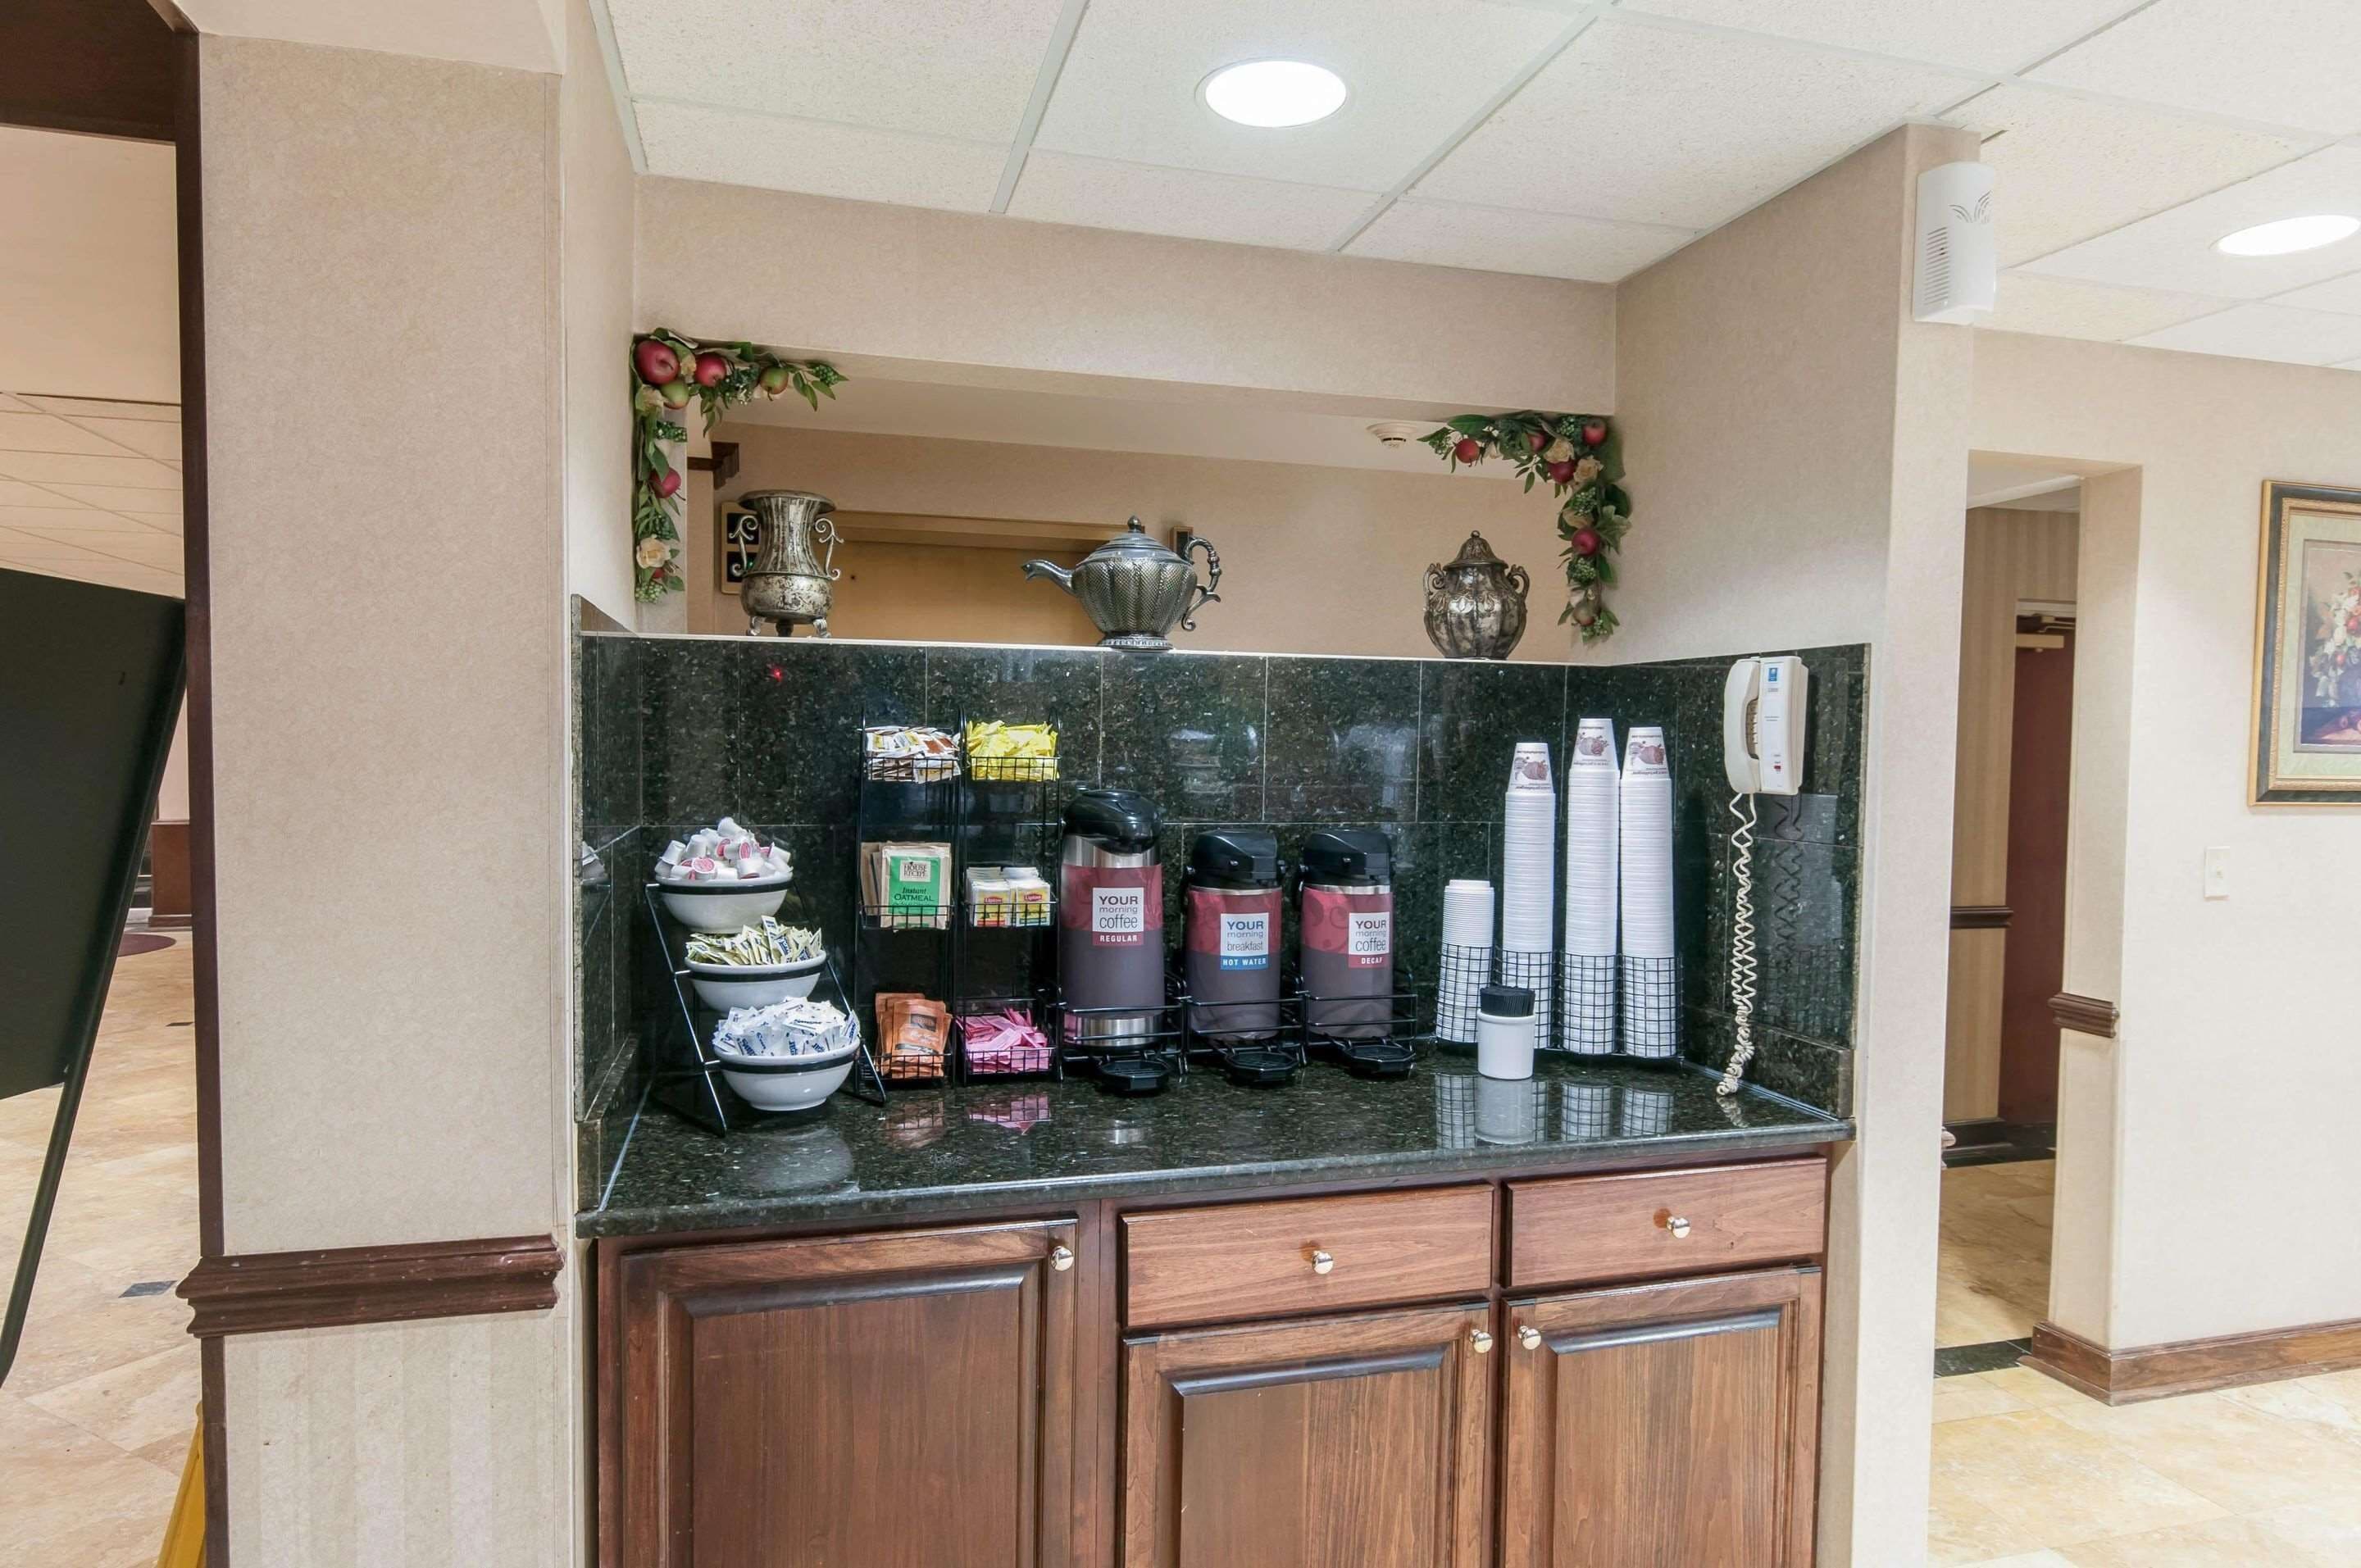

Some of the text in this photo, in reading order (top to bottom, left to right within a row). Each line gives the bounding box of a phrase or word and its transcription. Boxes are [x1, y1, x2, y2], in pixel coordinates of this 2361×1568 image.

[894, 893, 934, 902] OATMEAL
[1099, 896, 1139, 905] YOUR
[1099, 906, 1138, 914] morning
[1099, 914, 1138, 929] coffee
[1226, 920, 1264, 930] YOUR
[1355, 920, 1386, 929] YOUR
[1099, 934, 1137, 943] REGULAR
[1227, 942, 1263, 952] breakfast
[1355, 938, 1386, 952] coffee
